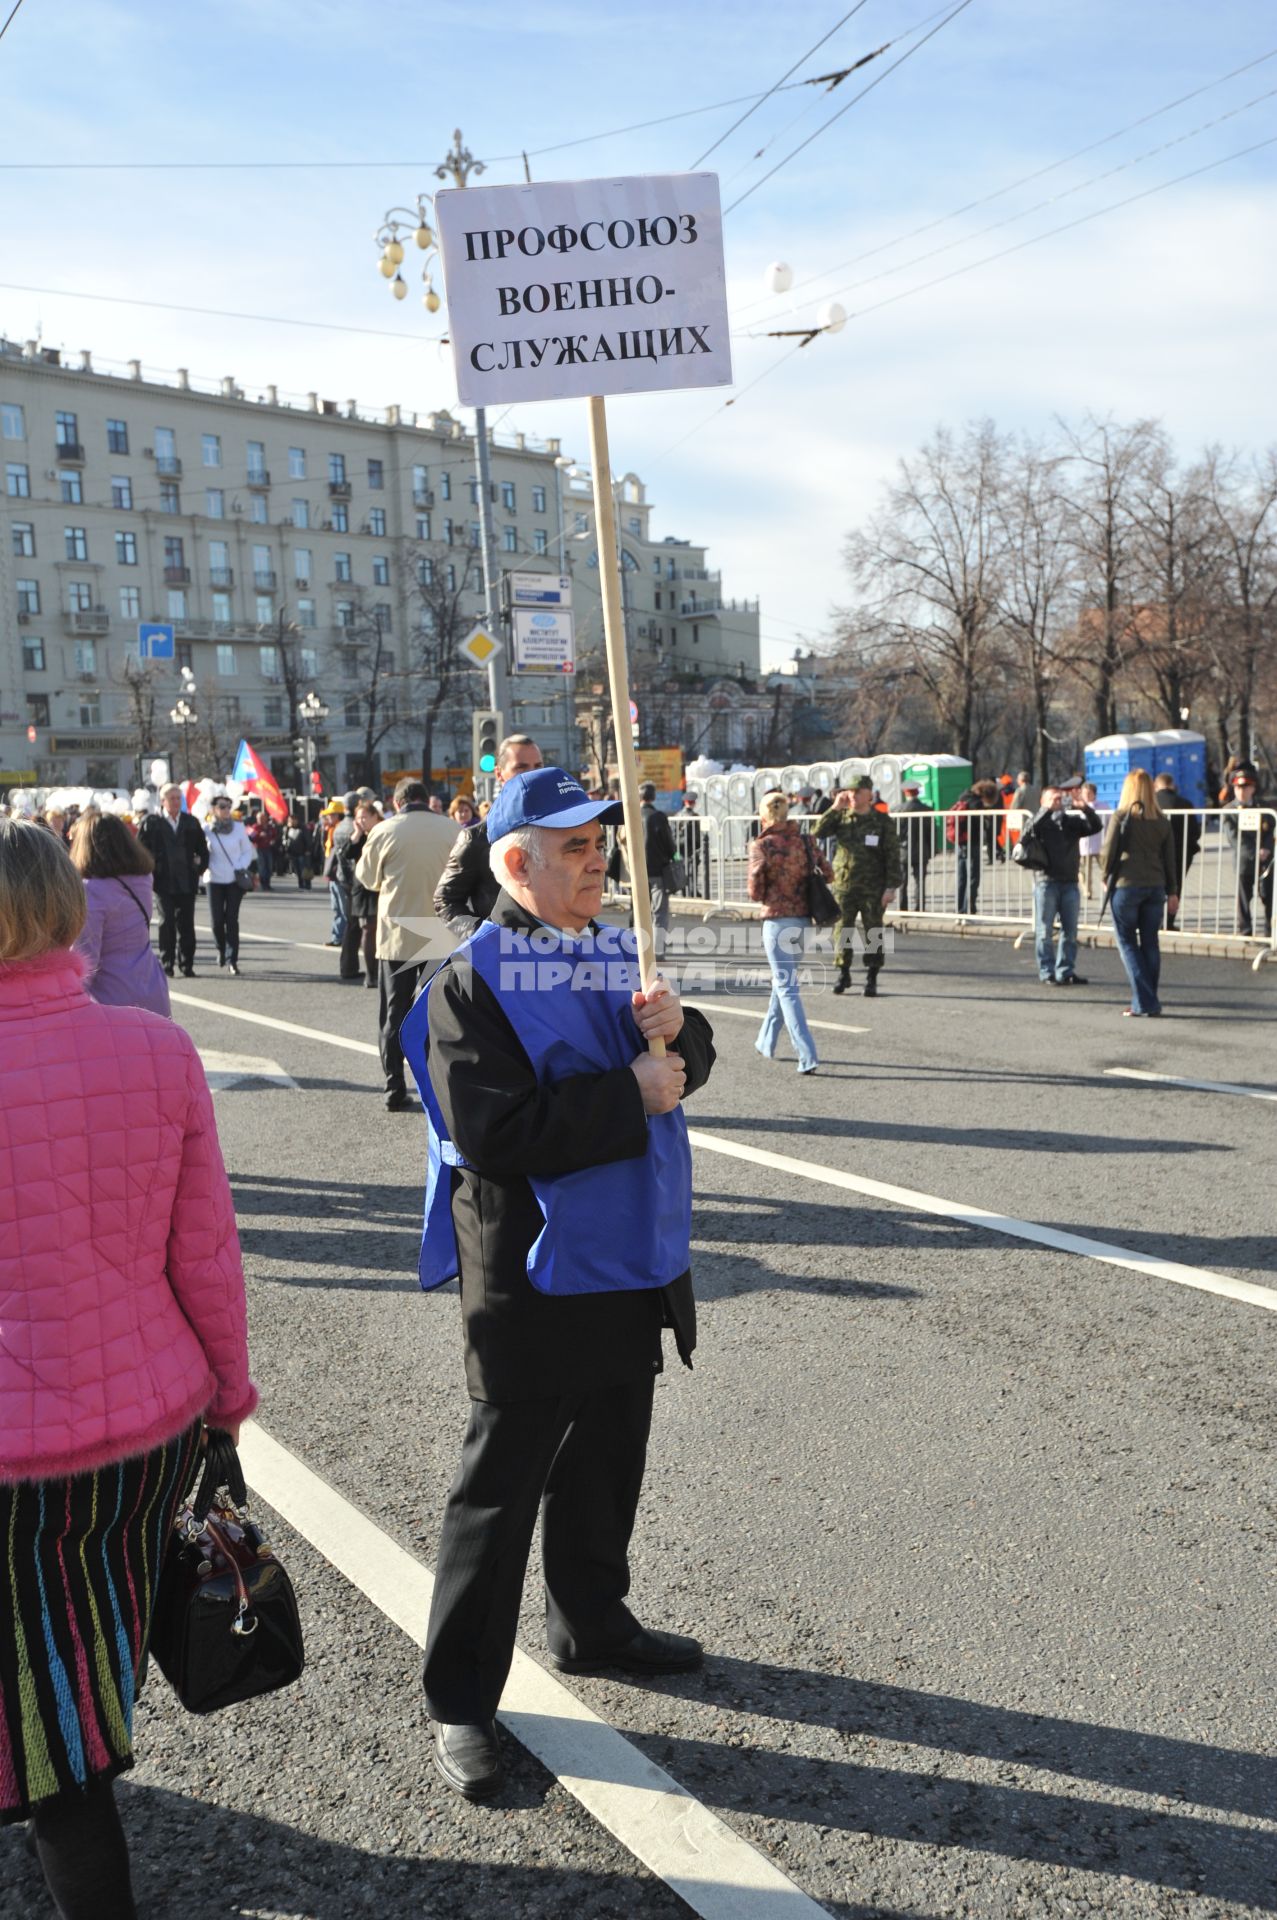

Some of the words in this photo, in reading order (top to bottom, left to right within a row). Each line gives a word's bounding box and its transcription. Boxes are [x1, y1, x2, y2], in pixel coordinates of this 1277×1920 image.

[463, 214, 698, 261] ПРОФСОЮЗ
[496, 275, 676, 316] ВОЕННО-
[469, 325, 712, 372] СЛУЖАЩИХ
